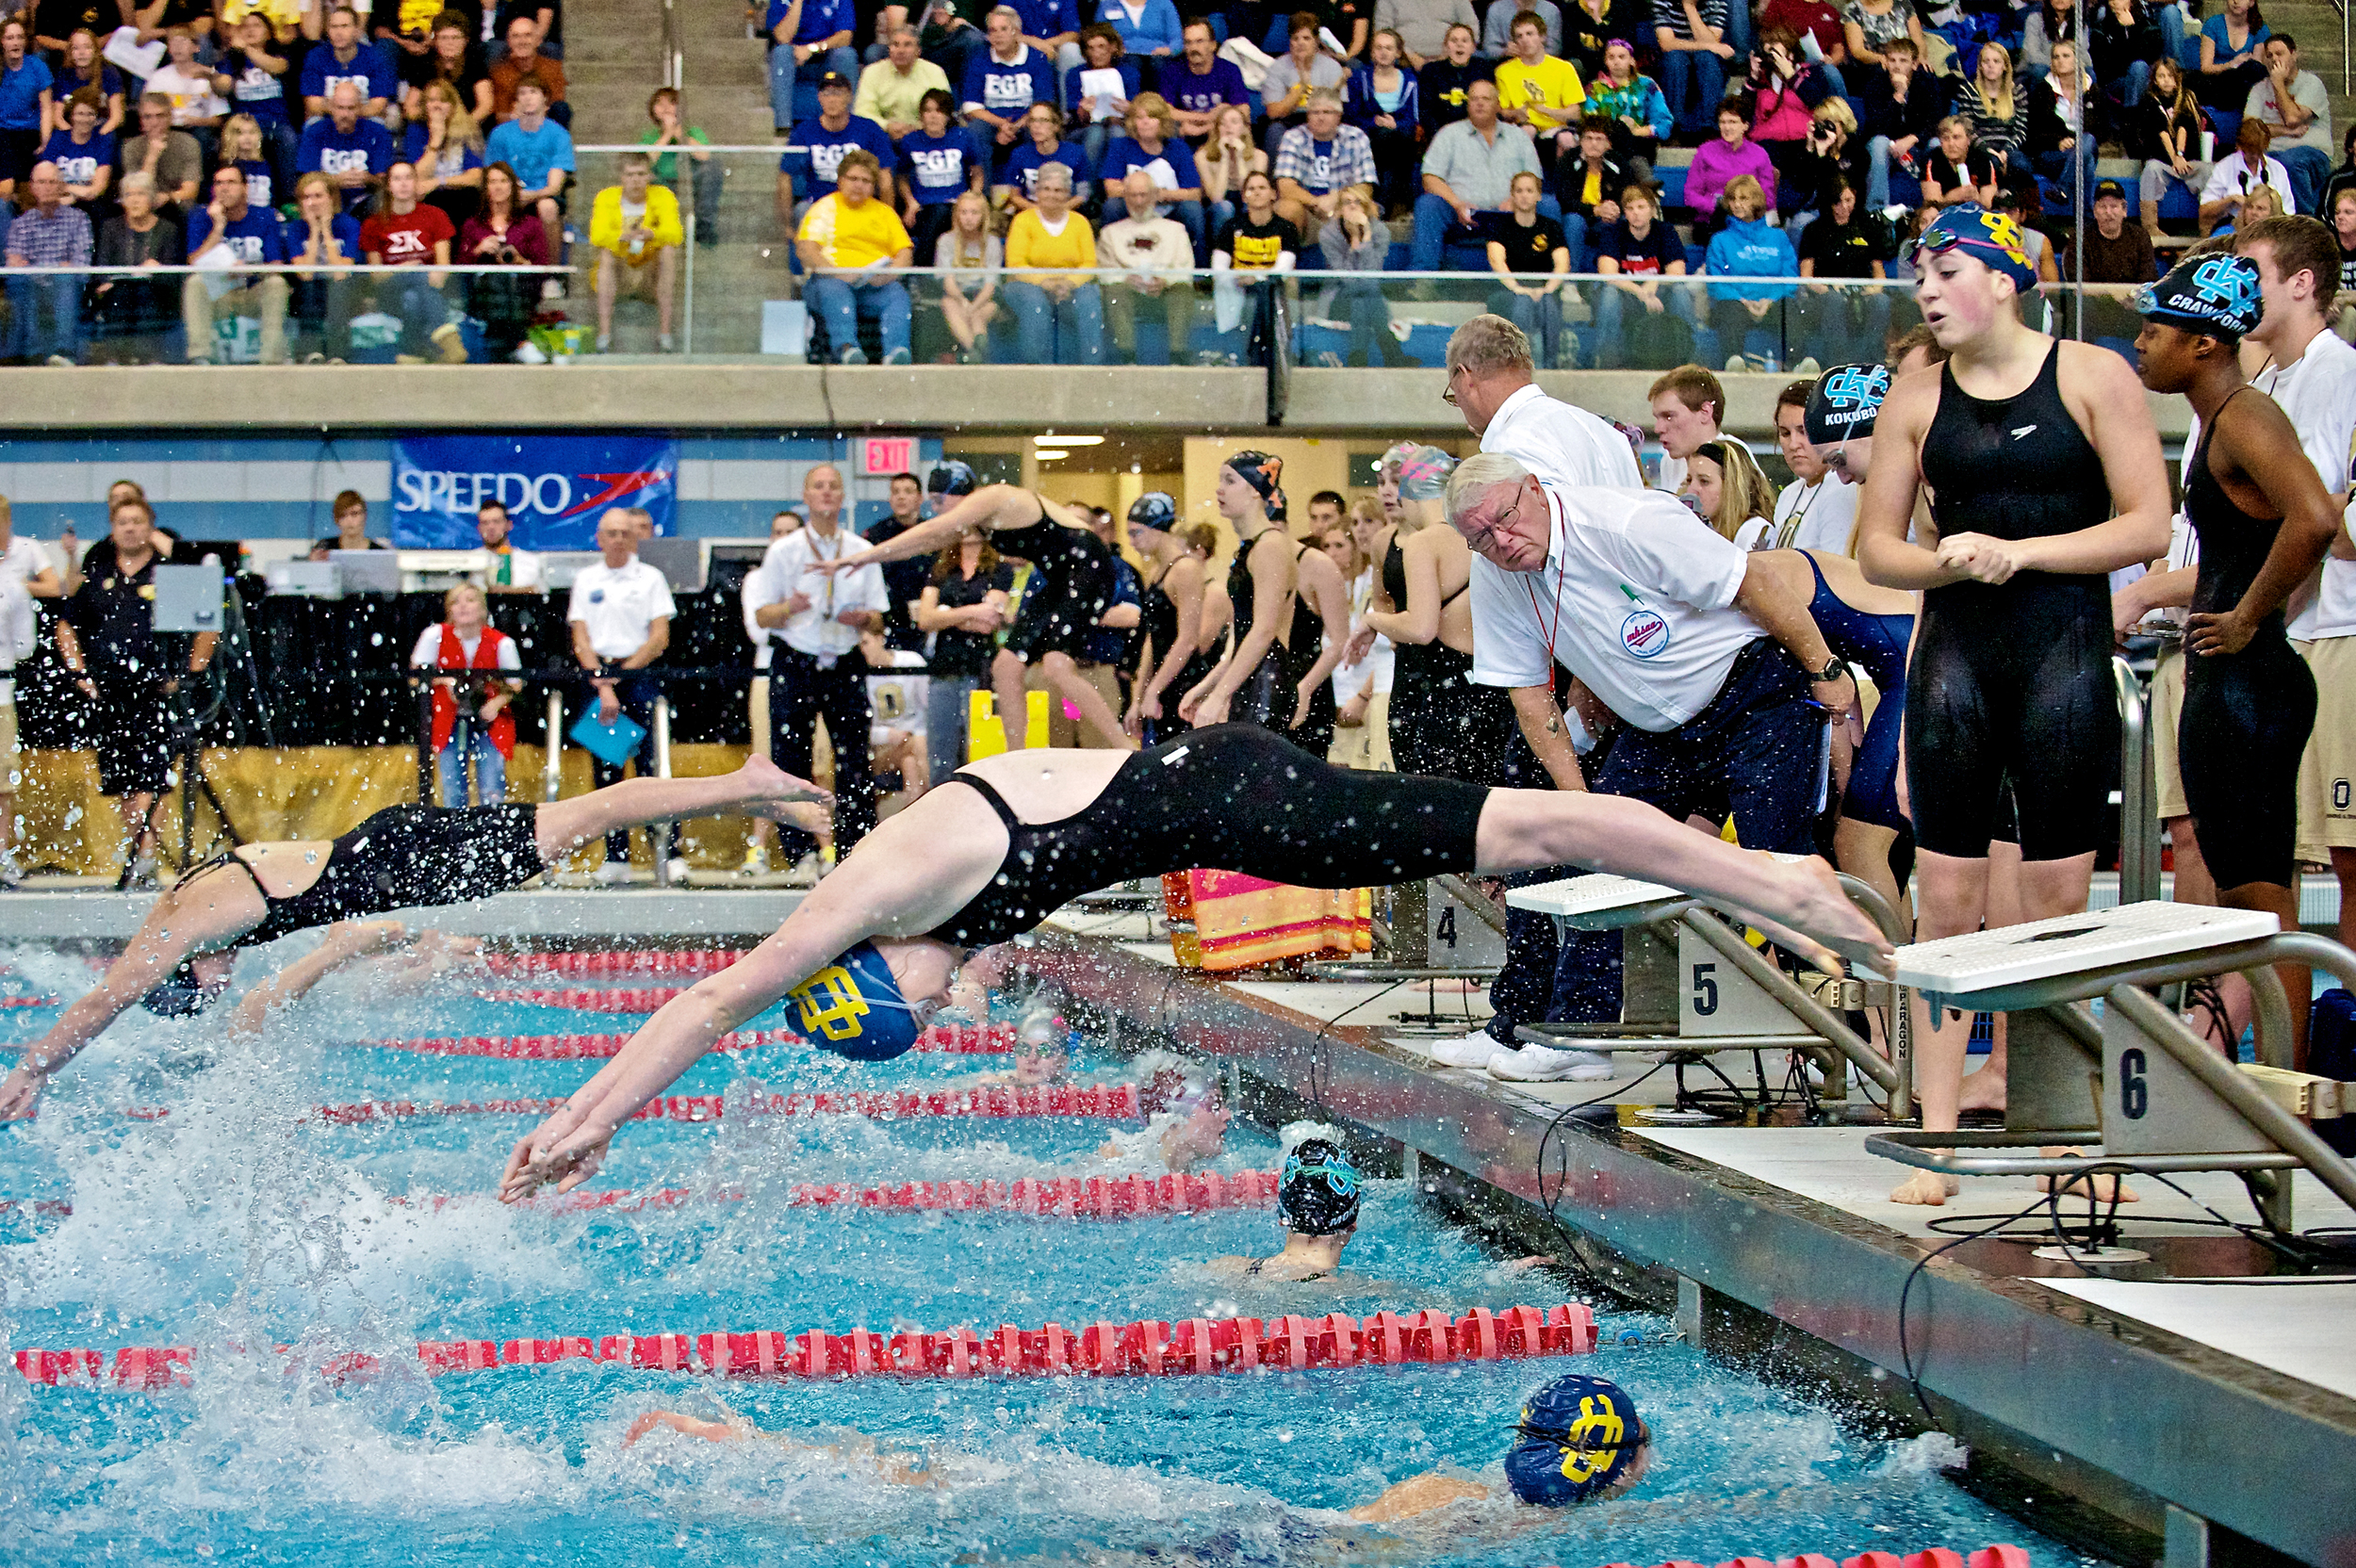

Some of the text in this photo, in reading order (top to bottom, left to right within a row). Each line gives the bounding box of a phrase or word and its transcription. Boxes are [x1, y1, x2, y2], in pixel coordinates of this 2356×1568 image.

[985, 74, 1032, 94] EGR
[320, 148, 368, 173] EGR
[910, 149, 962, 170] EGR
[1824, 407, 1878, 426] KOKUBO
[869, 443, 909, 471] EXIT
[395, 470, 572, 516] SPEEDO
[1436, 906, 1457, 948] 4
[1693, 963, 1718, 1016] 5
[1898, 992, 1907, 1059] PARAGON
[2119, 1048, 2148, 1119] 6
